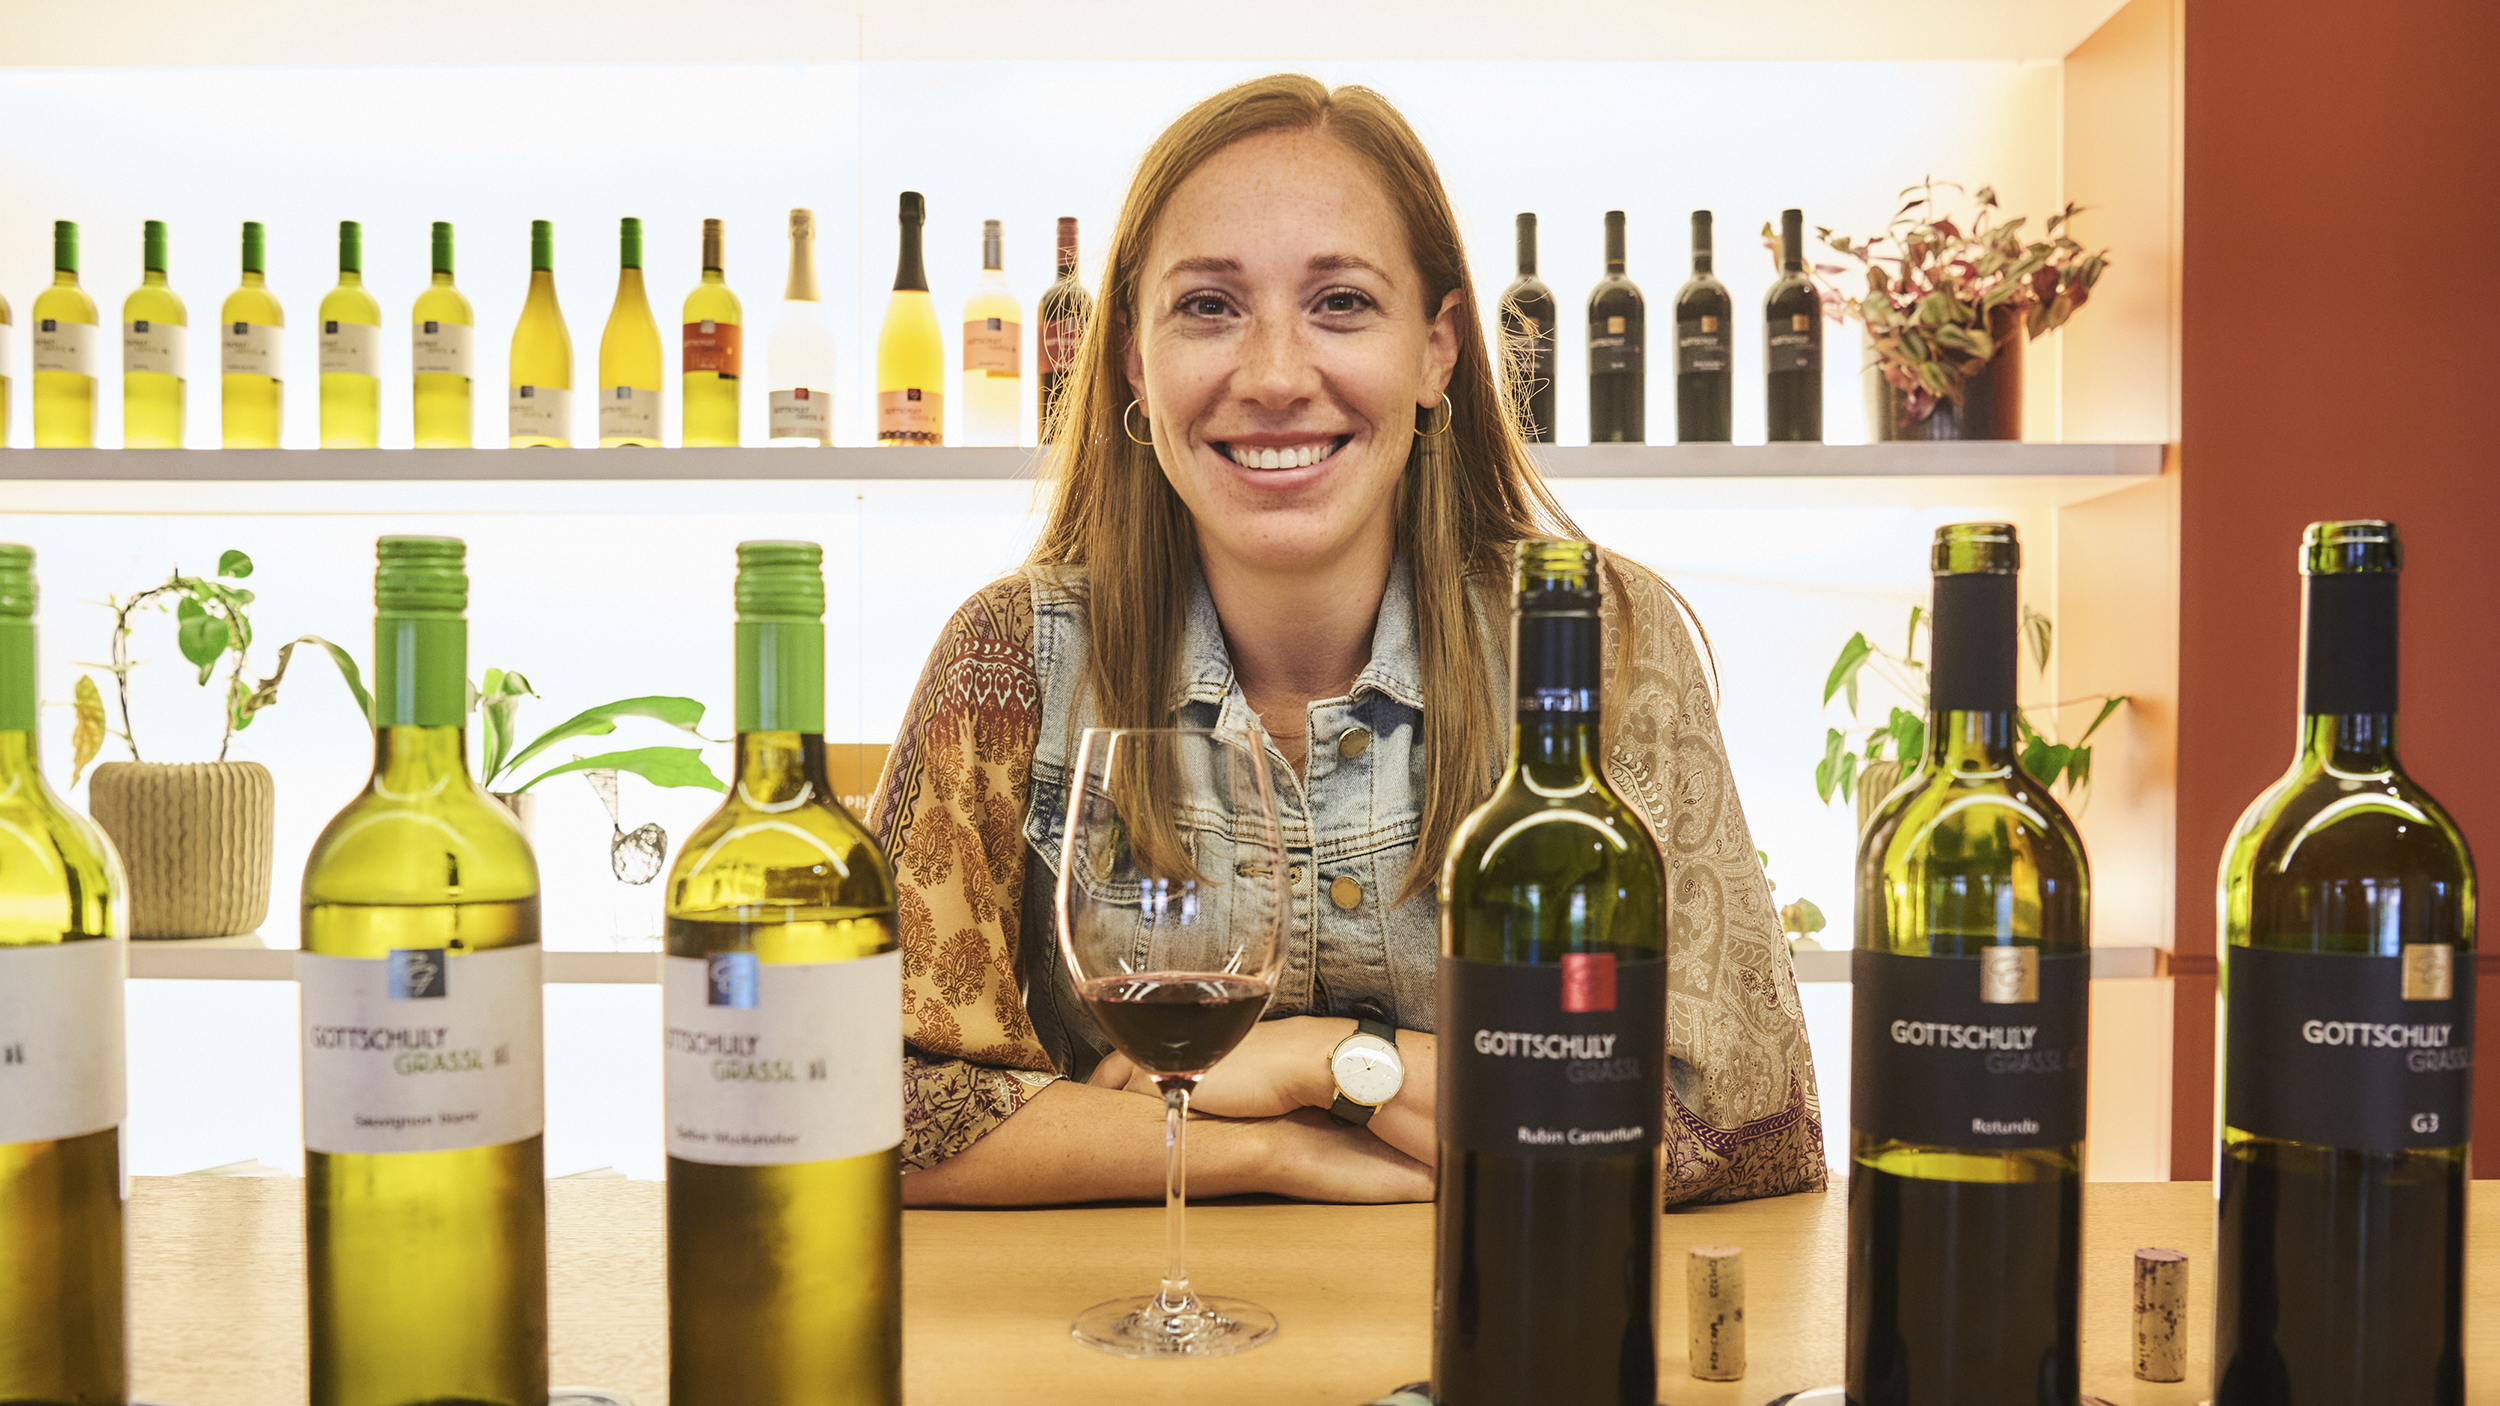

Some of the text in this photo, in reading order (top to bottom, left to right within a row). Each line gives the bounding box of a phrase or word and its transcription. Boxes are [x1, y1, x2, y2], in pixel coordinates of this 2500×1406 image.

[310, 1025, 448, 1051] GOTTSCHULY
[1474, 1029, 1616, 1059] GOTTSCHULY
[1891, 1020, 2037, 1050] GOTTSCHULY
[2302, 1019, 2452, 1048] GOTTSCHULY
[394, 1048, 484, 1076] GRASSL
[710, 1058, 796, 1083] GRASSL
[1517, 1125, 1645, 1145] Rubin Carnuntum
[2410, 1112, 2439, 1133] G3
